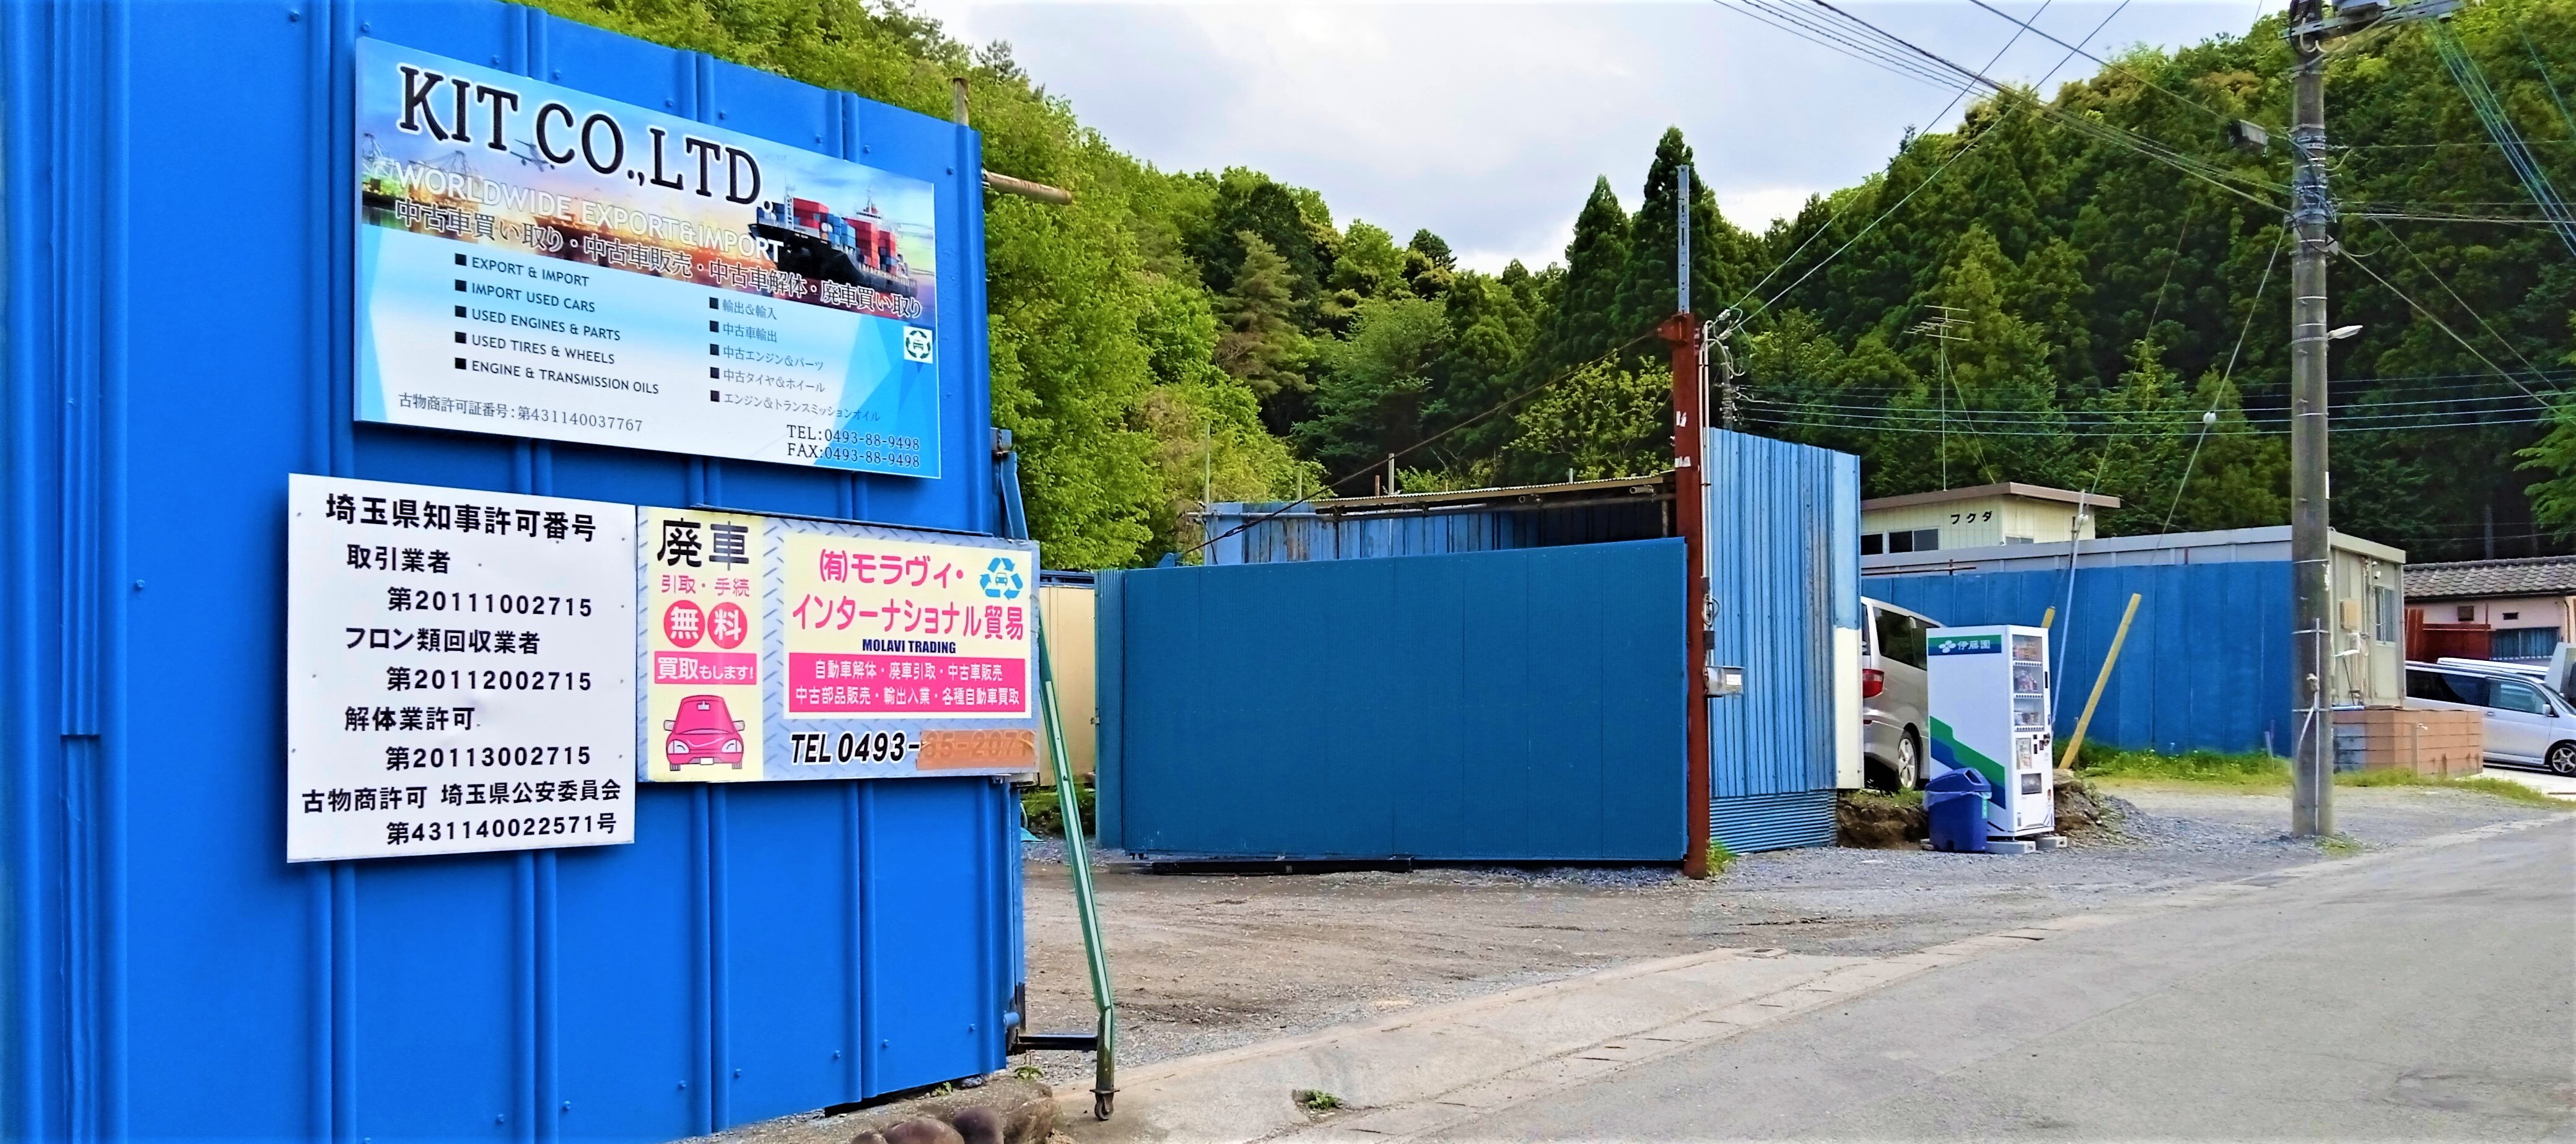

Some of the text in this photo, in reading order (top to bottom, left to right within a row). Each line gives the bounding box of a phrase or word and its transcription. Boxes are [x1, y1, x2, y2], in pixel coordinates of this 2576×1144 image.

[398, 65, 774, 211] KIT CO.,LTD.
[396, 162, 784, 263] WORLDWIDE EXPORT&IMPORT
[472, 256, 590, 287] EXPORT & IMPORT
[472, 282, 596, 313] IMPORT USED CARS
[472, 308, 621, 341] USED ENGINES & PARTS
[723, 322, 777, 343] 中古車輸出
[472, 334, 615, 365] USED TIRES & WHEELS
[472, 360, 659, 394] ENGINE & TRANSMISSION OILS
[325, 494, 596, 542] 埼玉県知事許可番号
[1950, 511, 1993, 525] フクダ
[346, 544, 451, 574] 取引業者
[657, 517, 749, 571] 廃車
[661, 575, 750, 597] 引取・手続
[387, 587, 592, 617] 第20111002715
[792, 594, 1024, 641] インターナショナル貿易
[346, 627, 540, 655] フロン類回収業者
[862, 639, 956, 654] MOLAVI TRADING
[386, 666, 592, 692] 第20112002715
[344, 707, 476, 731] 解体業許可
[386, 746, 591, 772] 第20113002715
[791, 733, 832, 763] TEL
[302, 779, 621, 814] 古物商許可 埼玉県公安委員会
[386, 812, 618, 845] 第431140022571号
